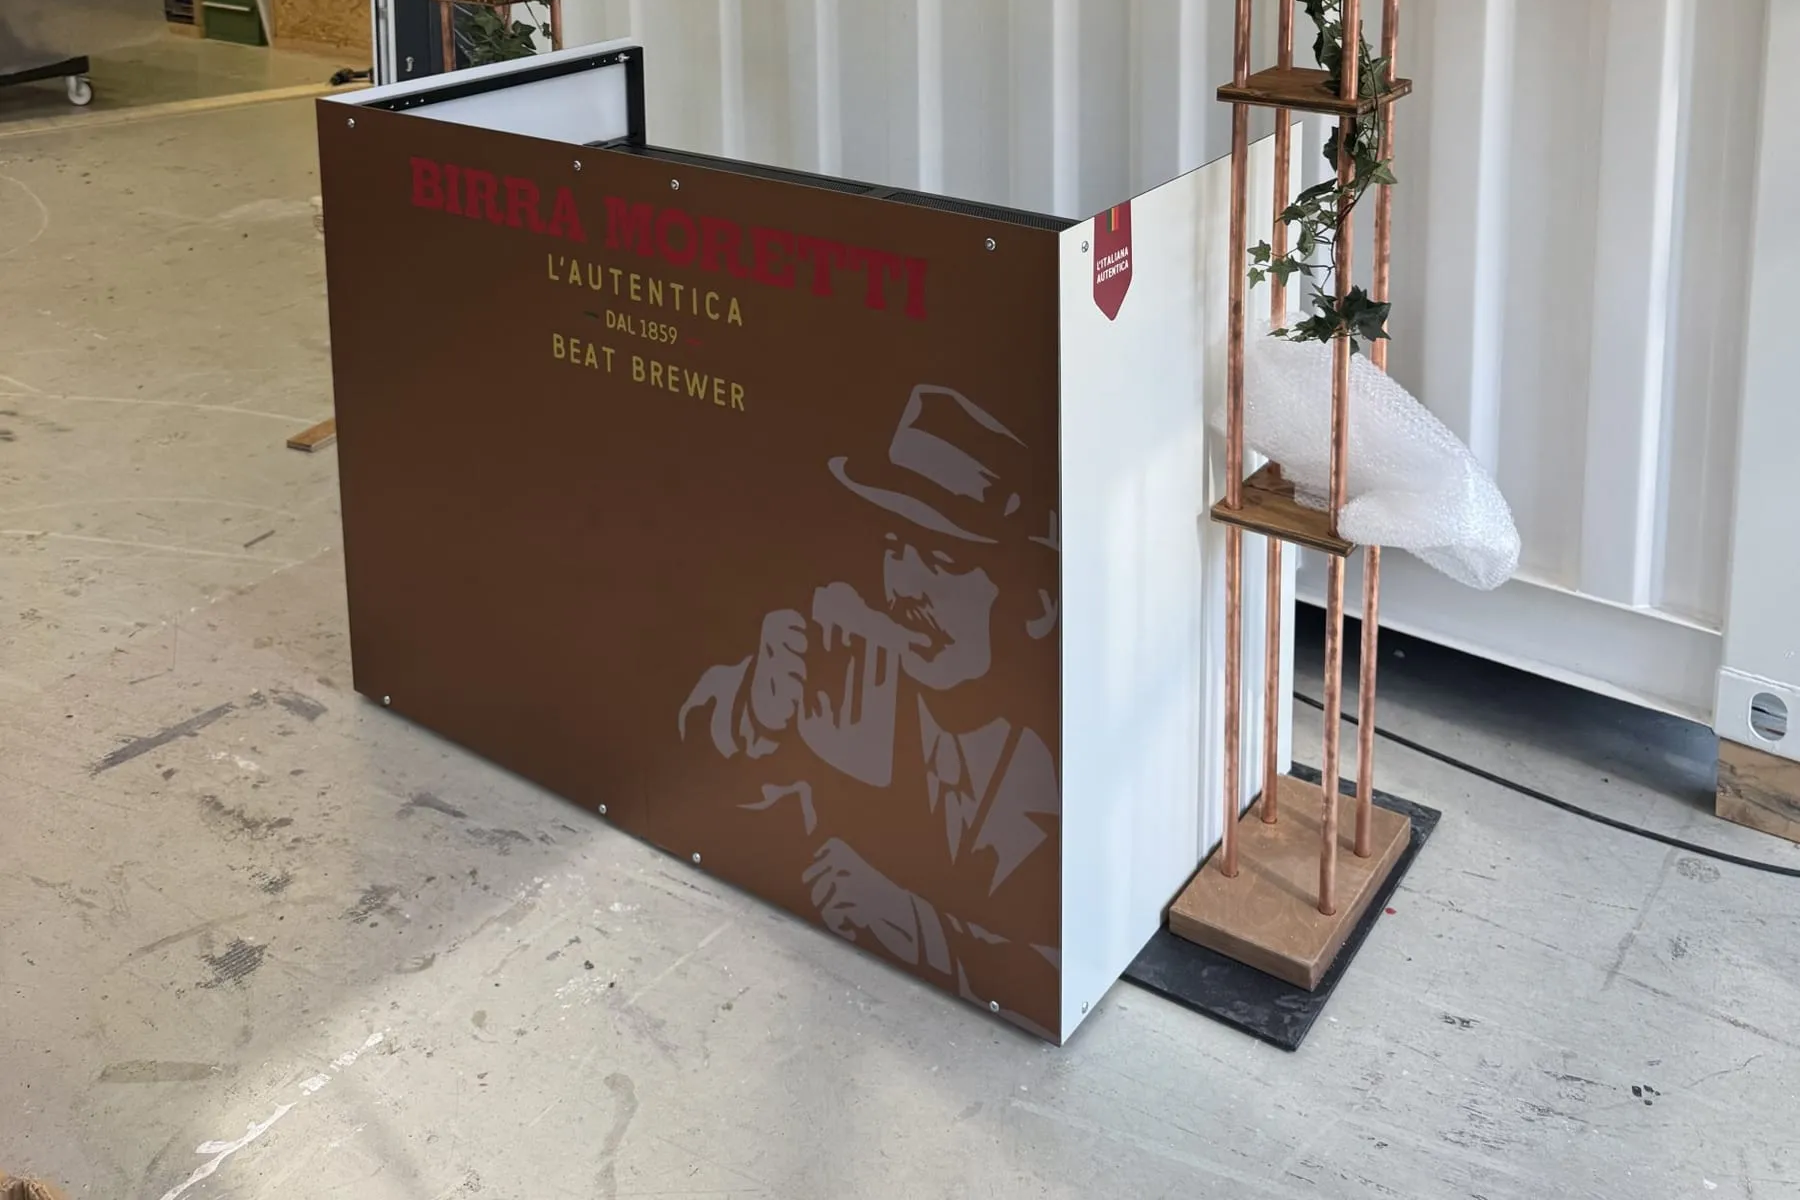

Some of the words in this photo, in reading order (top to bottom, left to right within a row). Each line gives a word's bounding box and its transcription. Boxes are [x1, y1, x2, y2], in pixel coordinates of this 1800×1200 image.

[410, 157, 587, 243] BIRRA
[603, 196, 929, 320] MORETTI
[1096, 246, 1129, 270] L'ITALIANA
[547, 253, 744, 327] L'AUTENTICA
[1096, 260, 1129, 284] AUTENTICA
[605, 309, 636, 336] DAL
[639, 318, 678, 345] 1859
[552, 333, 616, 373] BEAT
[631, 356, 746, 411] BREWER
